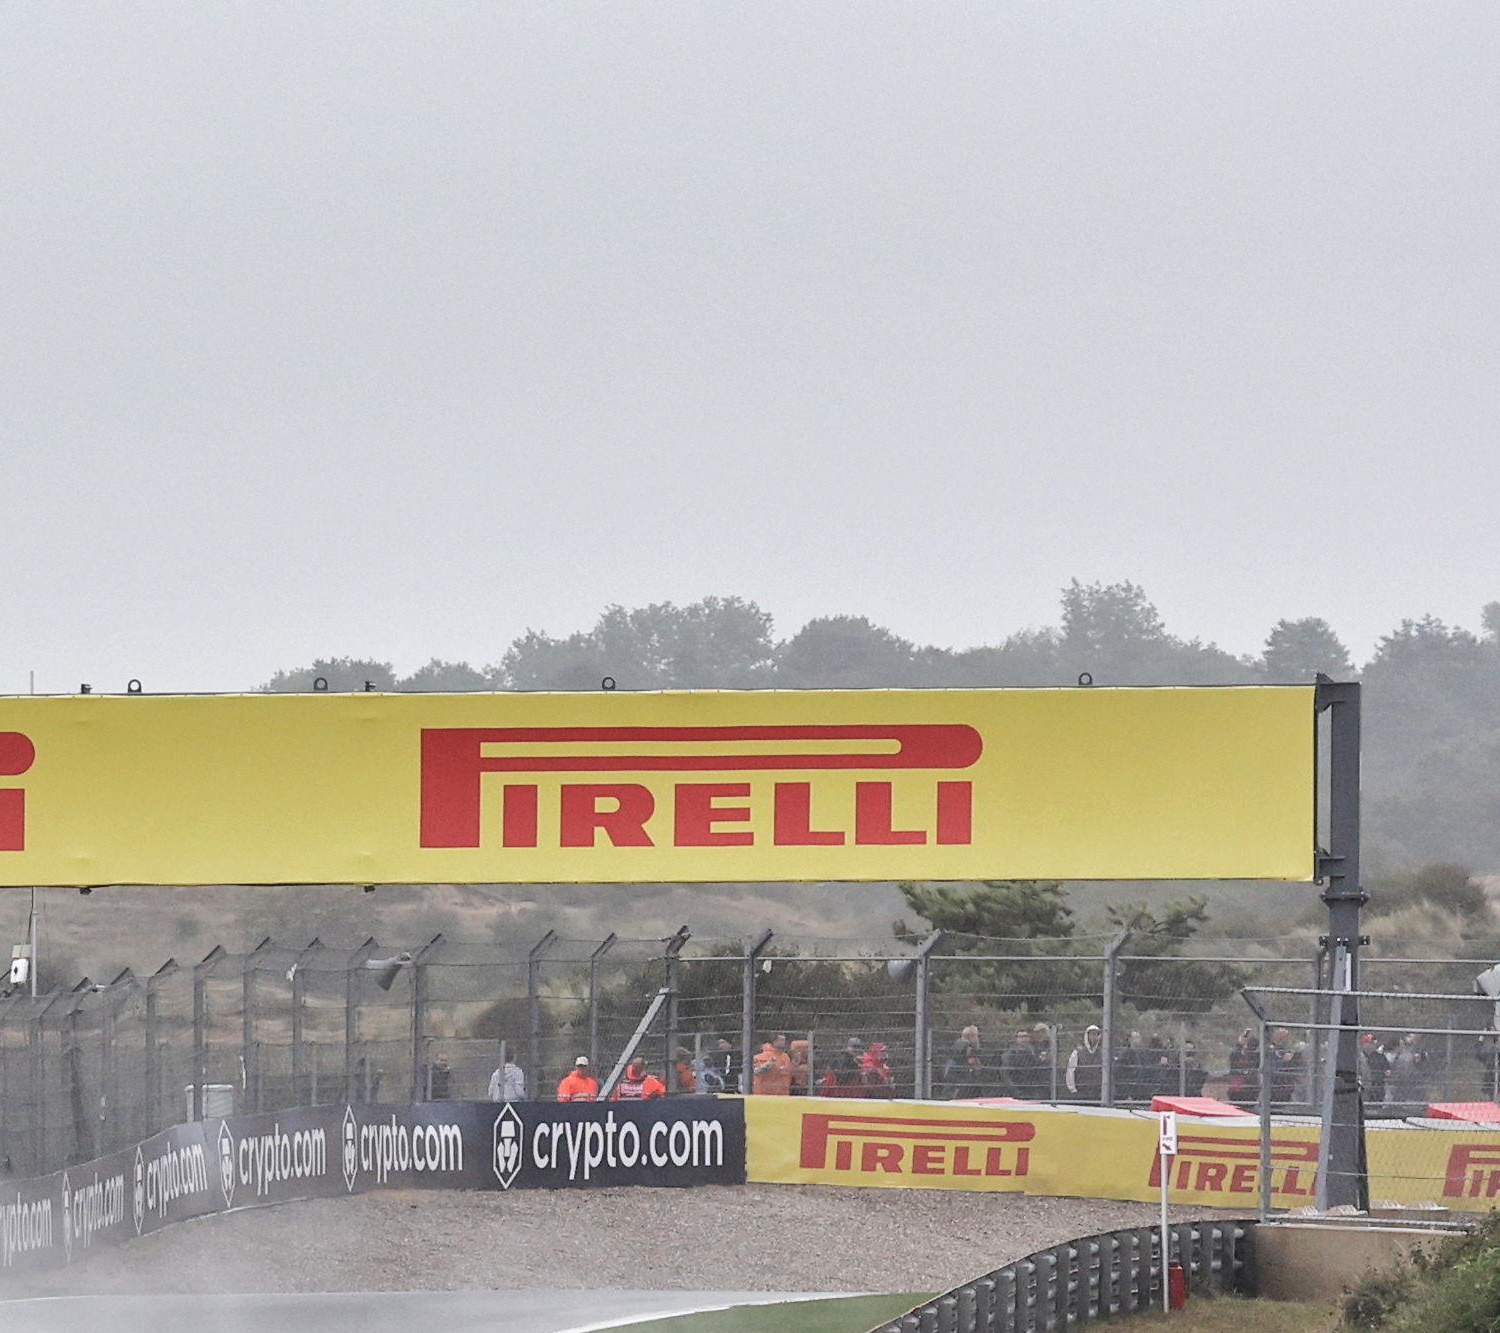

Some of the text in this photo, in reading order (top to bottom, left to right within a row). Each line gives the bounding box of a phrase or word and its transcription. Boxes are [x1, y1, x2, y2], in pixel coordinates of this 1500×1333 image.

[420, 723, 984, 849] PIRELLI
[146, 1141, 208, 1219] crypto.com
[239, 1123, 326, 1196] crypto.com
[360, 1114, 463, 1184] crypto.com
[533, 1110, 724, 1180] crypto.com
[799, 1113, 1036, 1177] PIRELLI
[73, 1172, 125, 1248] crypto.com
